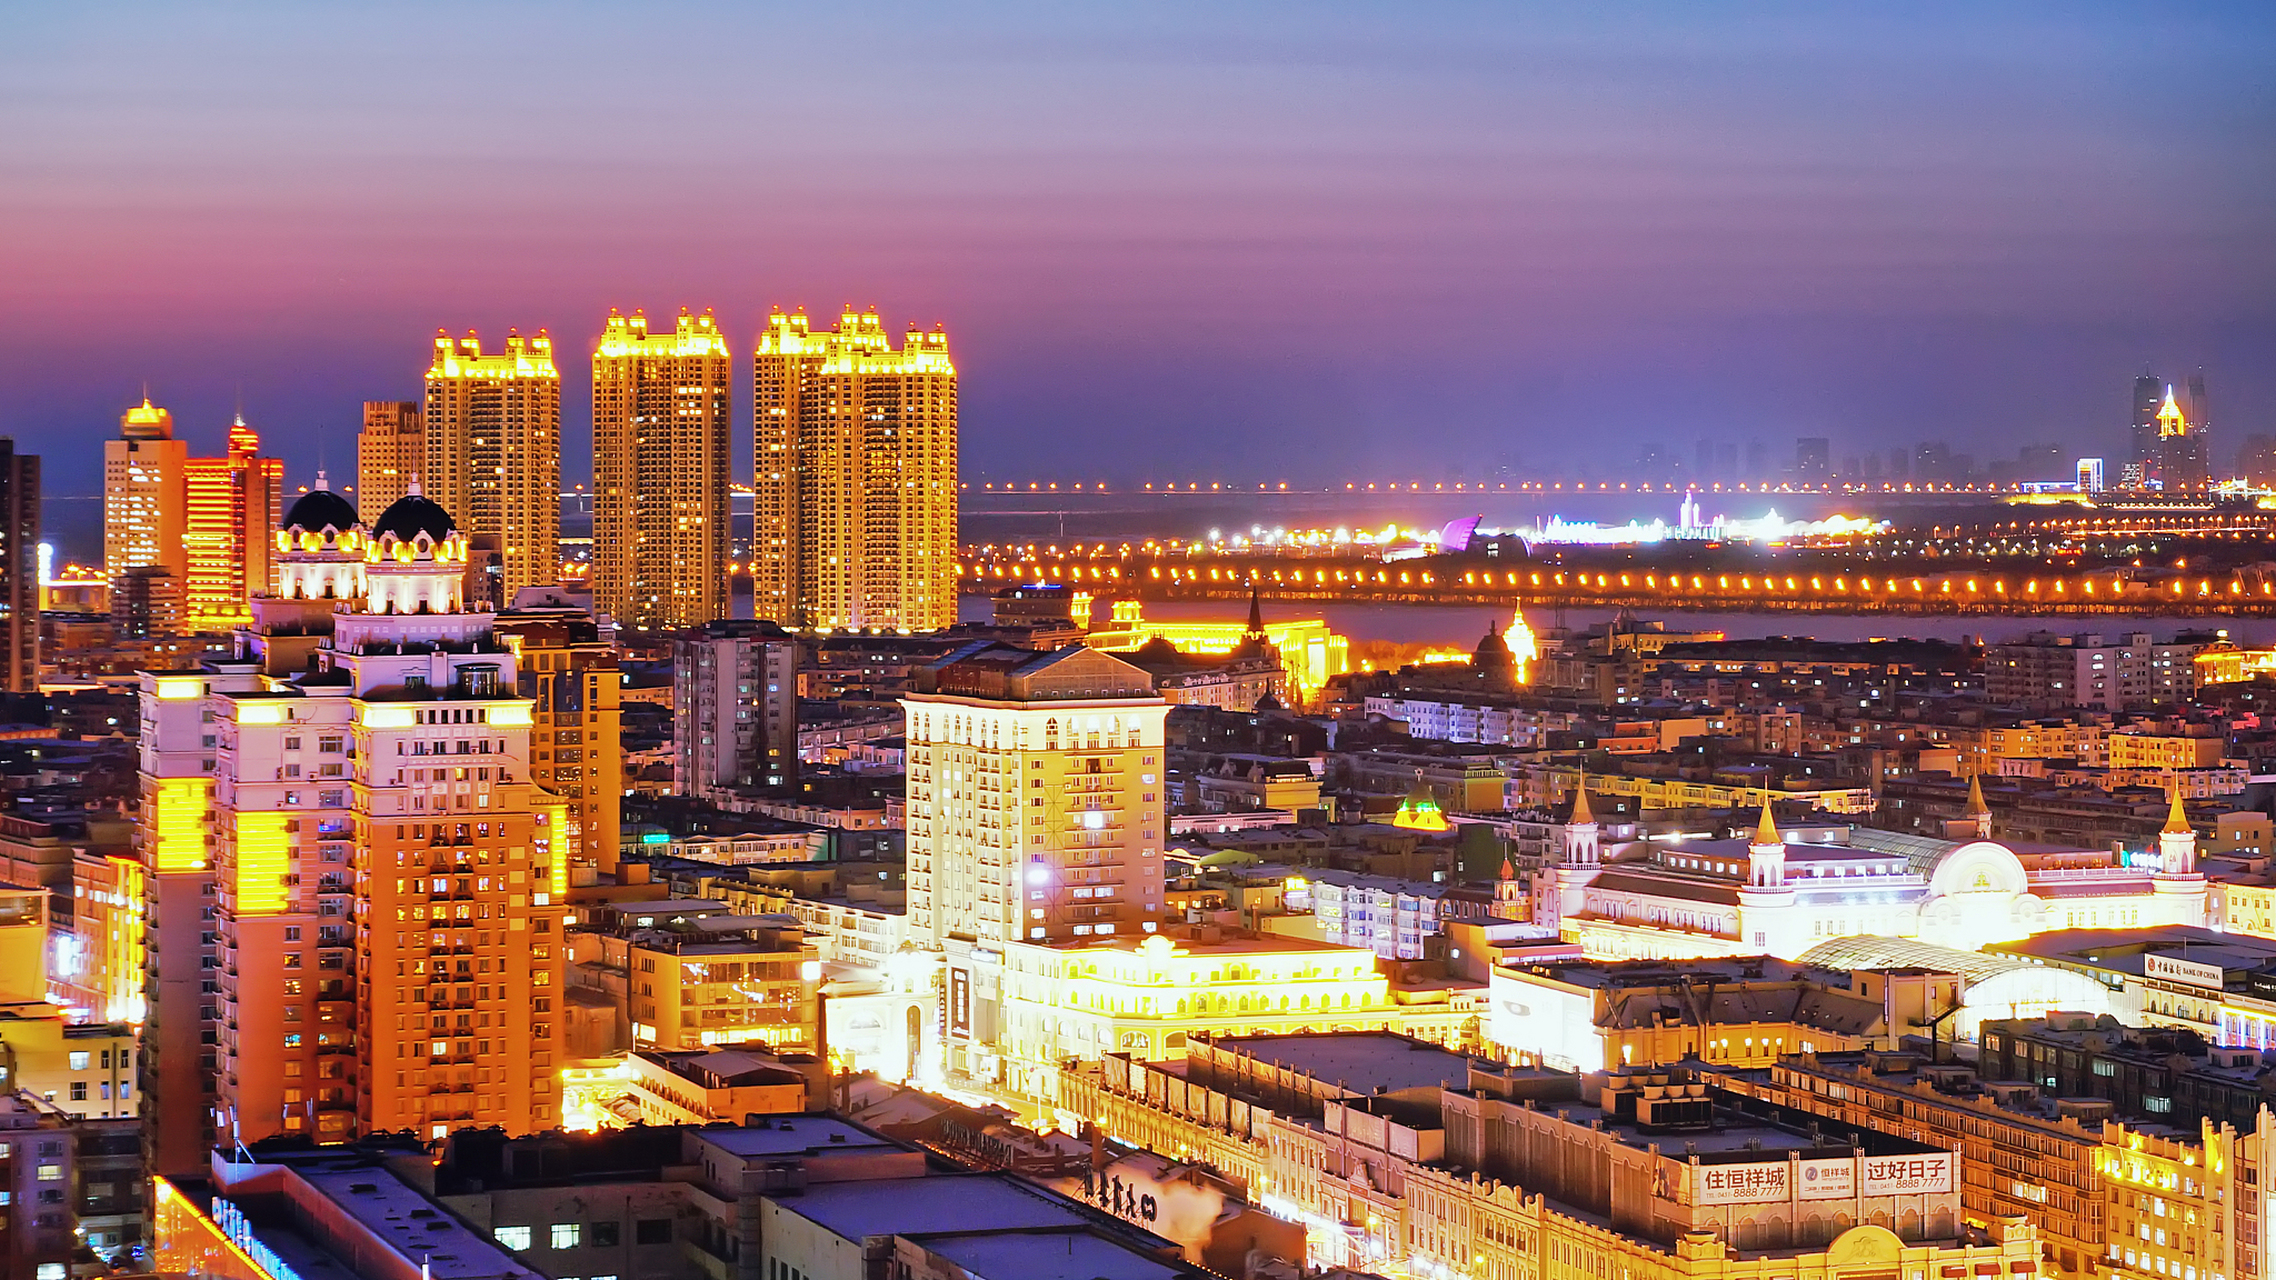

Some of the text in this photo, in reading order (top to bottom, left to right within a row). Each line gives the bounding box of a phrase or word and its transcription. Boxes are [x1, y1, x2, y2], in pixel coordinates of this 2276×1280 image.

[2183, 967, 2219, 980] BANK OF CHINA
[1868, 1160, 1945, 1180] 过好日子
[1705, 1167, 1785, 1189] 住恒祥城
[1922, 1178, 1945, 1187] 7777
[1760, 1187, 1784, 1196] 7777
